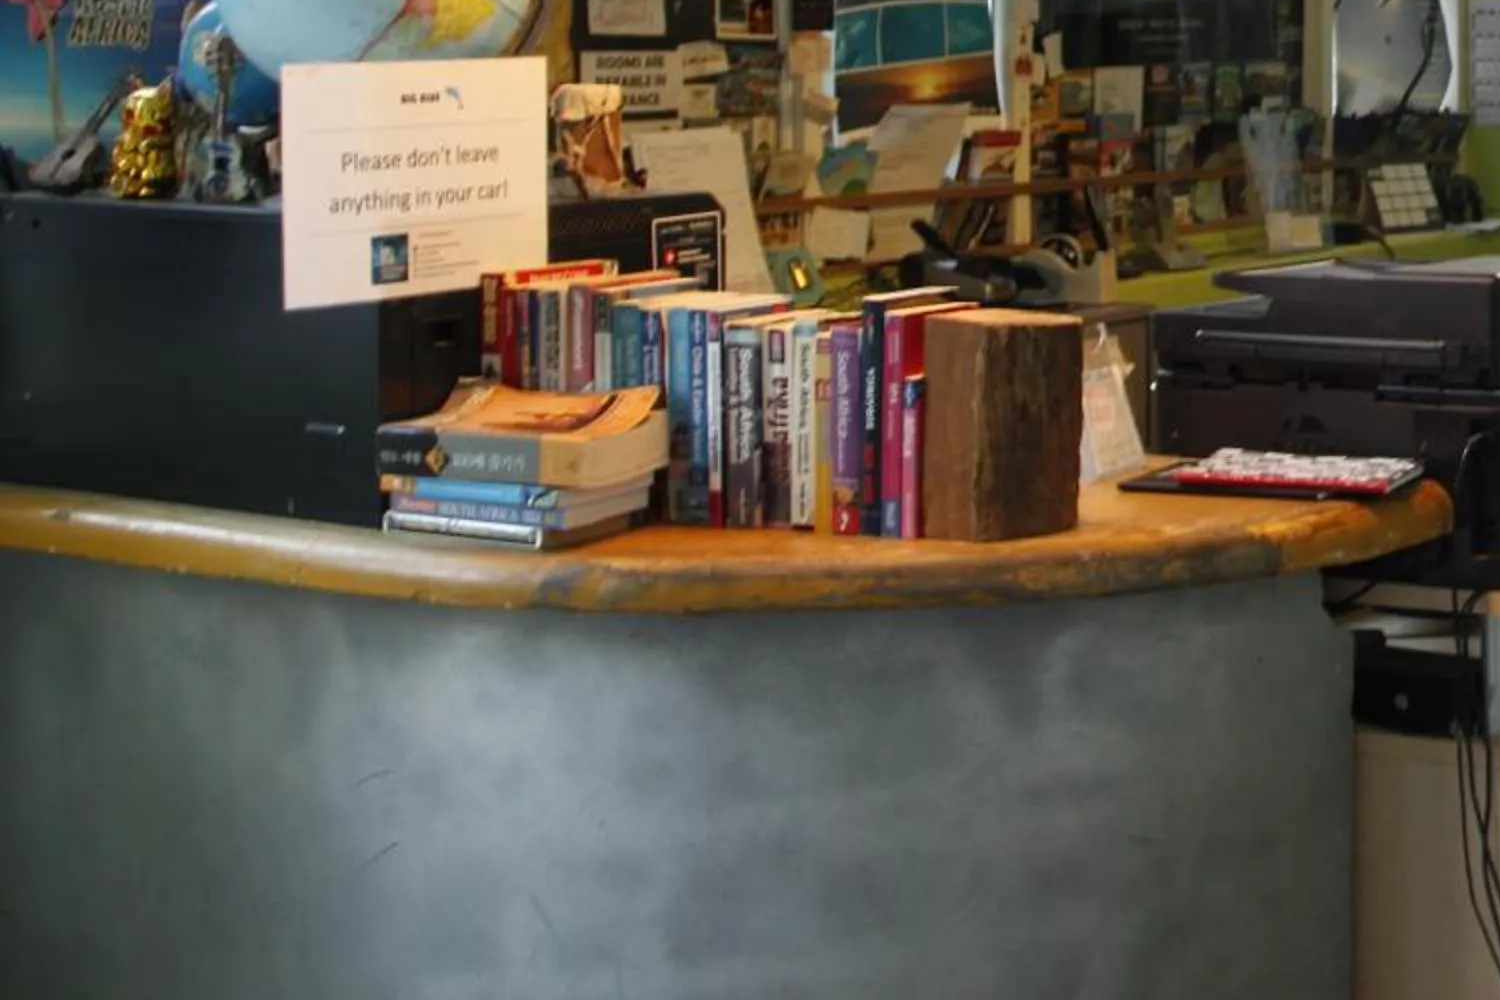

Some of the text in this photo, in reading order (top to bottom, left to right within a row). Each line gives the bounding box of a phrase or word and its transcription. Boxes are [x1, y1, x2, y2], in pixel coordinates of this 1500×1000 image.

[340, 144, 499, 172] Please don't leave
[328, 180, 509, 215] anything in your car!
[739, 348, 754, 402] South
[837, 351, 851, 394] South
[837, 396, 851, 438] Africa
